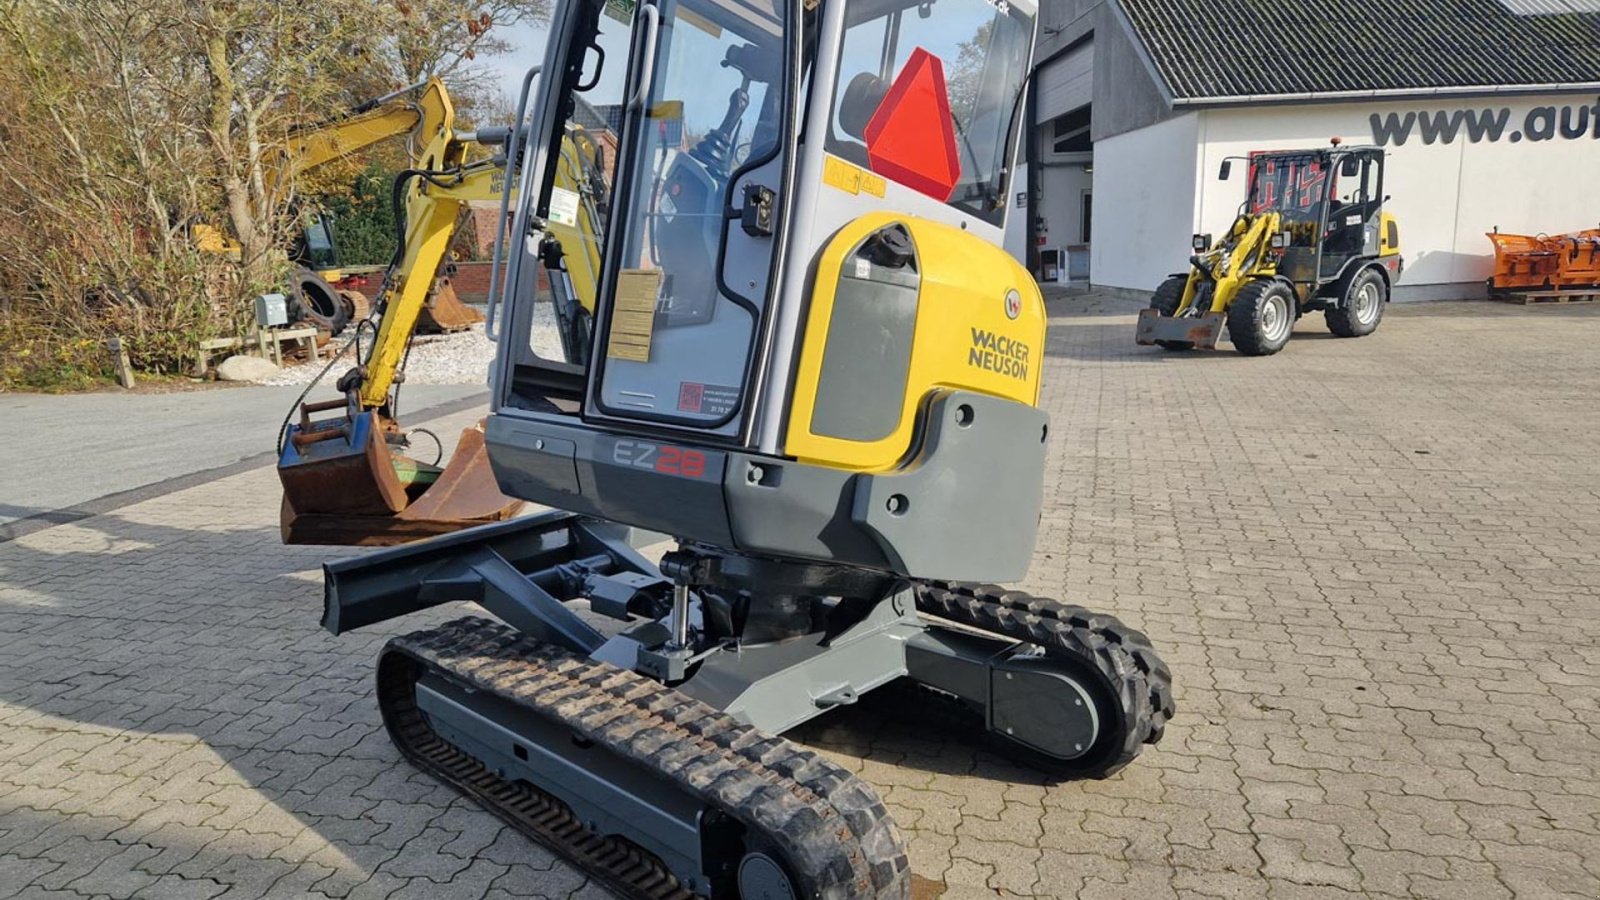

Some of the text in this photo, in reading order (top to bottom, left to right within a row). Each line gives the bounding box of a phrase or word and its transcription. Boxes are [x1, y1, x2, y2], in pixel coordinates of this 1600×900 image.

[971, 327, 1029, 363] WACKER
[968, 347, 1028, 382] NEUSON
[613, 440, 705, 478] EZ28
